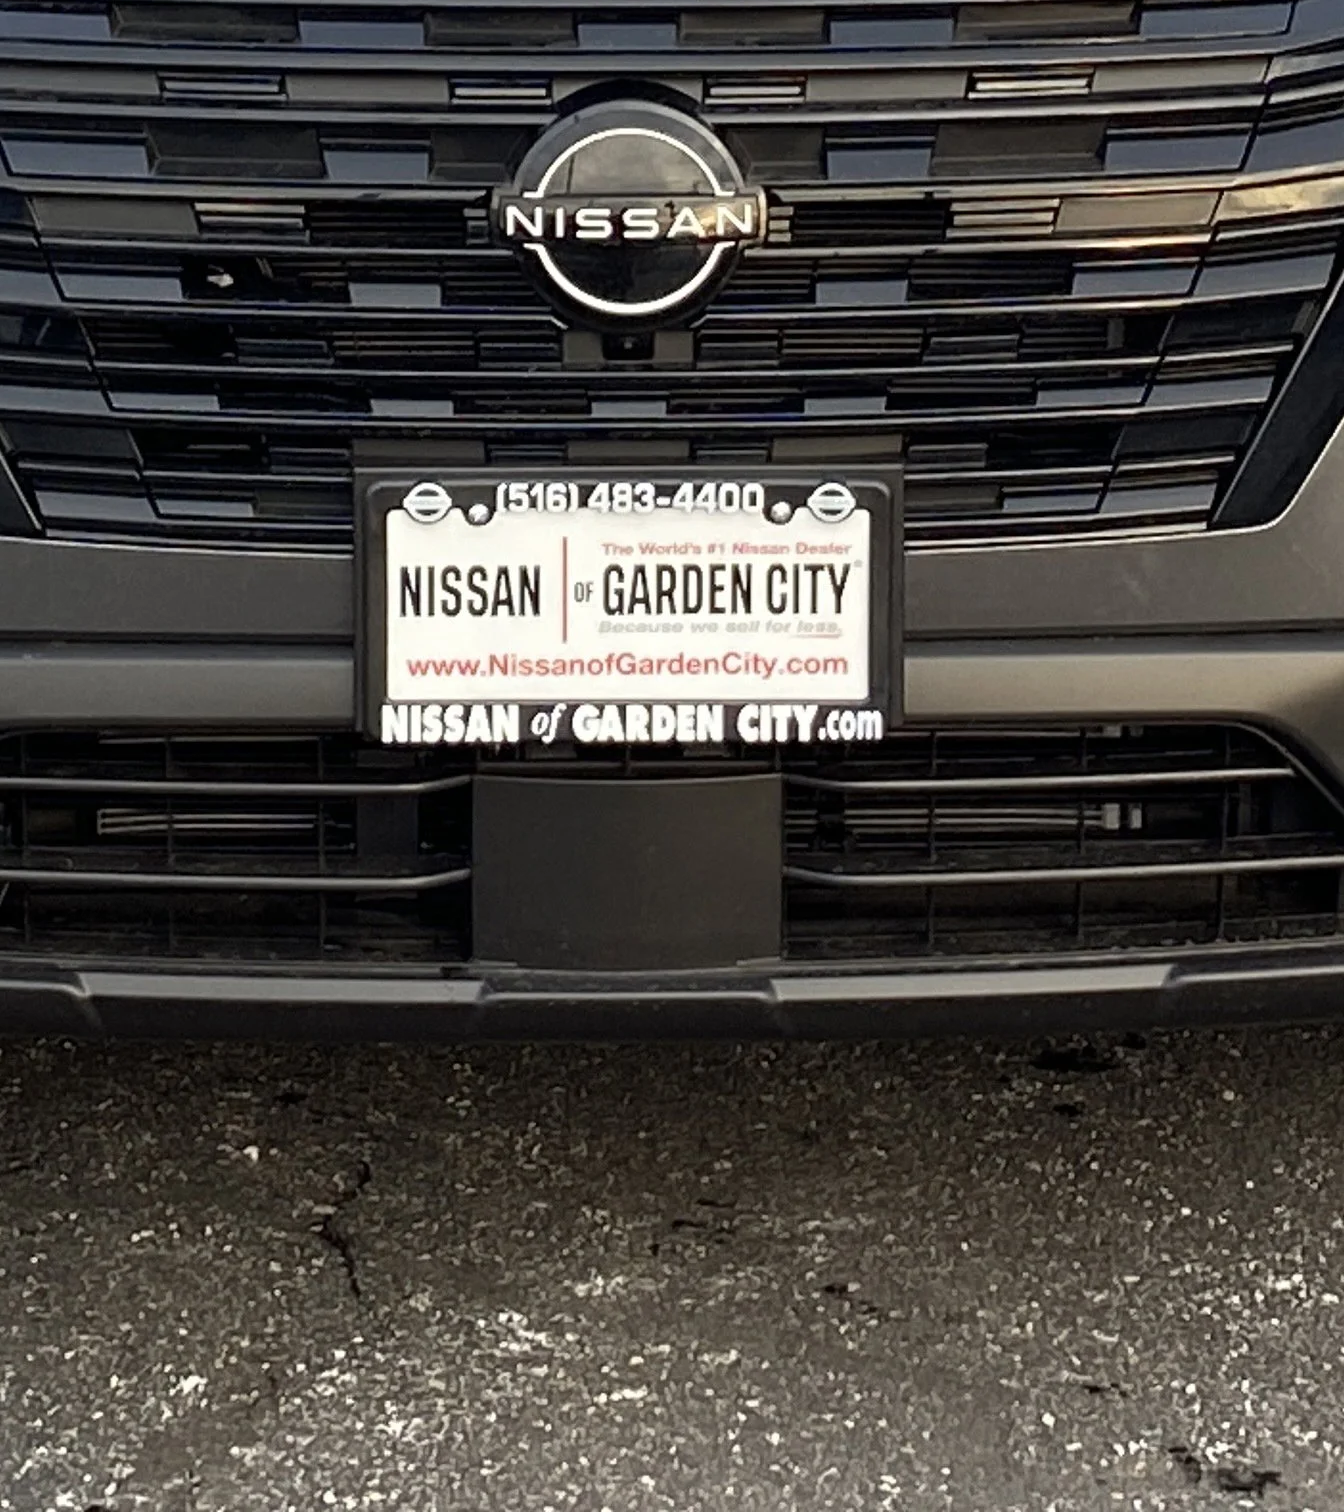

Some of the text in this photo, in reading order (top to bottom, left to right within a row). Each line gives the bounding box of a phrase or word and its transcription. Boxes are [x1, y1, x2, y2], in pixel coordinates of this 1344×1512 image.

[506, 205, 753, 238] NISSAN
[495, 482, 765, 513] (516) 483-4400
[601, 541, 853, 556] The World's #1 Nissan Dealer
[399, 562, 852, 617] NISSAN OF GARDEN CITY
[598, 620, 685, 634] Because
[689, 623, 718, 634] we
[765, 620, 792, 634] for
[406, 651, 850, 680] www.NissanofGardenCity.com
[381, 701, 884, 745] NISSAN of GARDEN CITY.com
